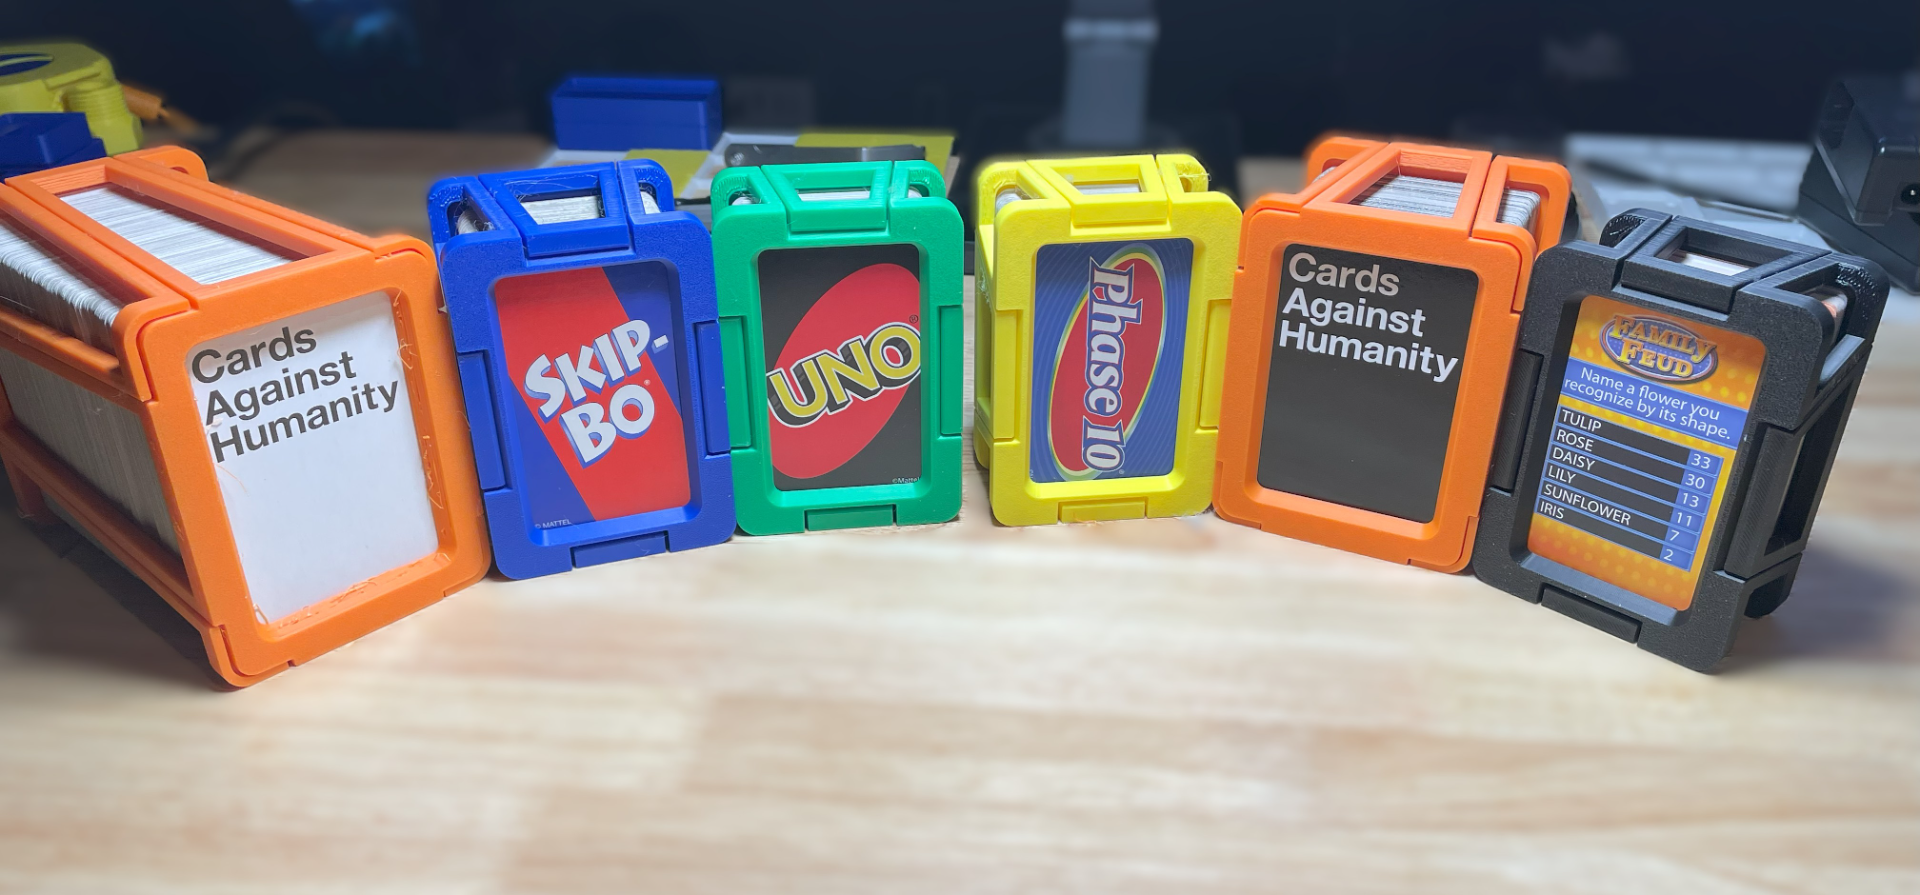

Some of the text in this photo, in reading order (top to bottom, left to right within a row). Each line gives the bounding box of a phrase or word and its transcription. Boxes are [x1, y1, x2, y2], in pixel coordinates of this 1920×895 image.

[1288, 252, 1400, 297] Cards
[1282, 287, 1426, 337] Against
[1608, 314, 1718, 363] FAMILY
[191, 326, 317, 384] Cards
[523, 319, 669, 424] SKIP-
[766, 321, 921, 428] UNO
[1081, 255, 1144, 473] Phase 10
[1279, 320, 1459, 383] Humanity
[1616, 337, 1694, 378] FEUD
[205, 351, 357, 421] Against
[1564, 378, 1731, 440] recognize by its shape.
[1580, 366, 1720, 421] Name a flower you
[210, 380, 398, 463] Humanity
[559, 384, 655, 469] BO
[1562, 409, 1711, 469] TULIP 33
[1552, 447, 1699, 508] DAISY 13
[1556, 429, 1705, 489] ROSE 30
[542, 519, 572, 529] MATTEL
[1544, 484, 1680, 542] SUNFLOWER 7
[1548, 465, 1692, 527] LILY 11
[1540, 501, 1674, 561] IRIS 2
